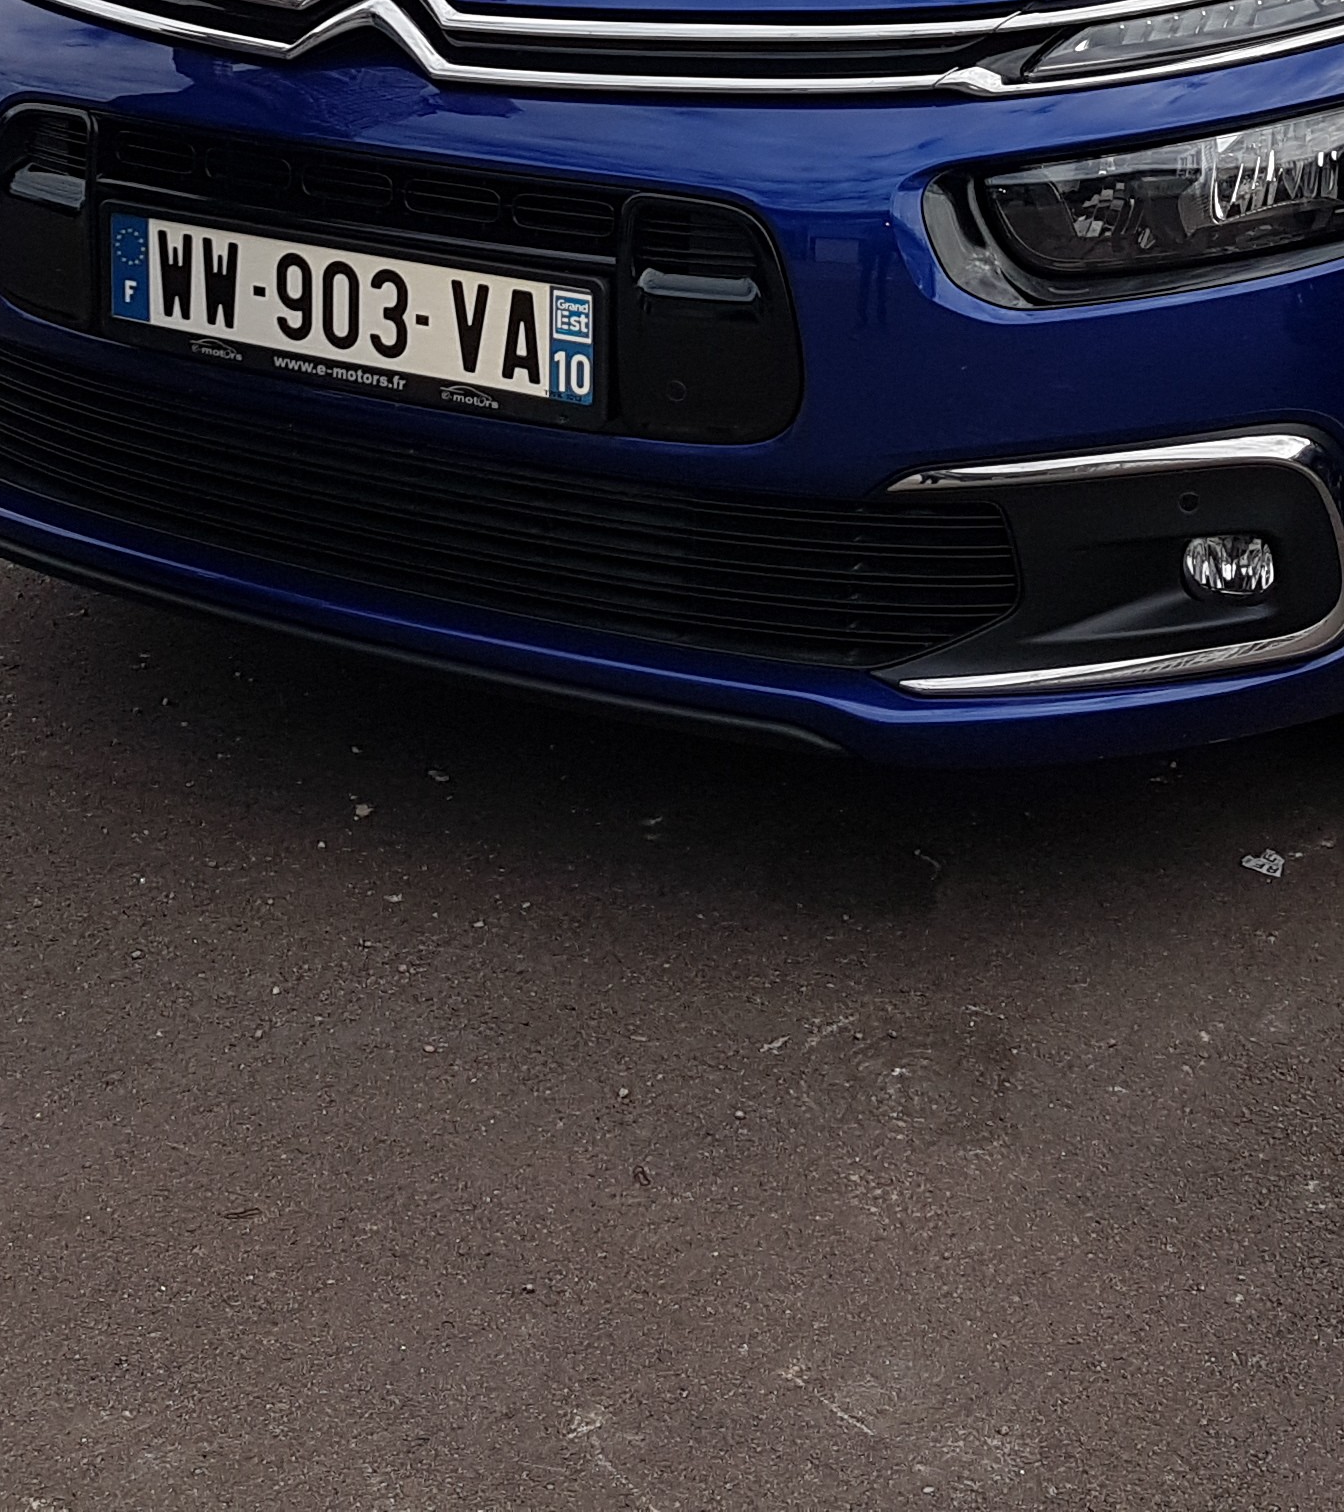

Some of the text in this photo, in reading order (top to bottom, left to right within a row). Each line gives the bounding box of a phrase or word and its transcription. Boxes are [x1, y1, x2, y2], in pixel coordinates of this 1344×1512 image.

[124, 280, 137, 304] F
[157, 228, 542, 386] WW-903-VA
[557, 298, 589, 314] Grand
[557, 311, 589, 333] Est
[273, 355, 406, 391] www.e-motors.fr
[554, 350, 591, 396] 10
